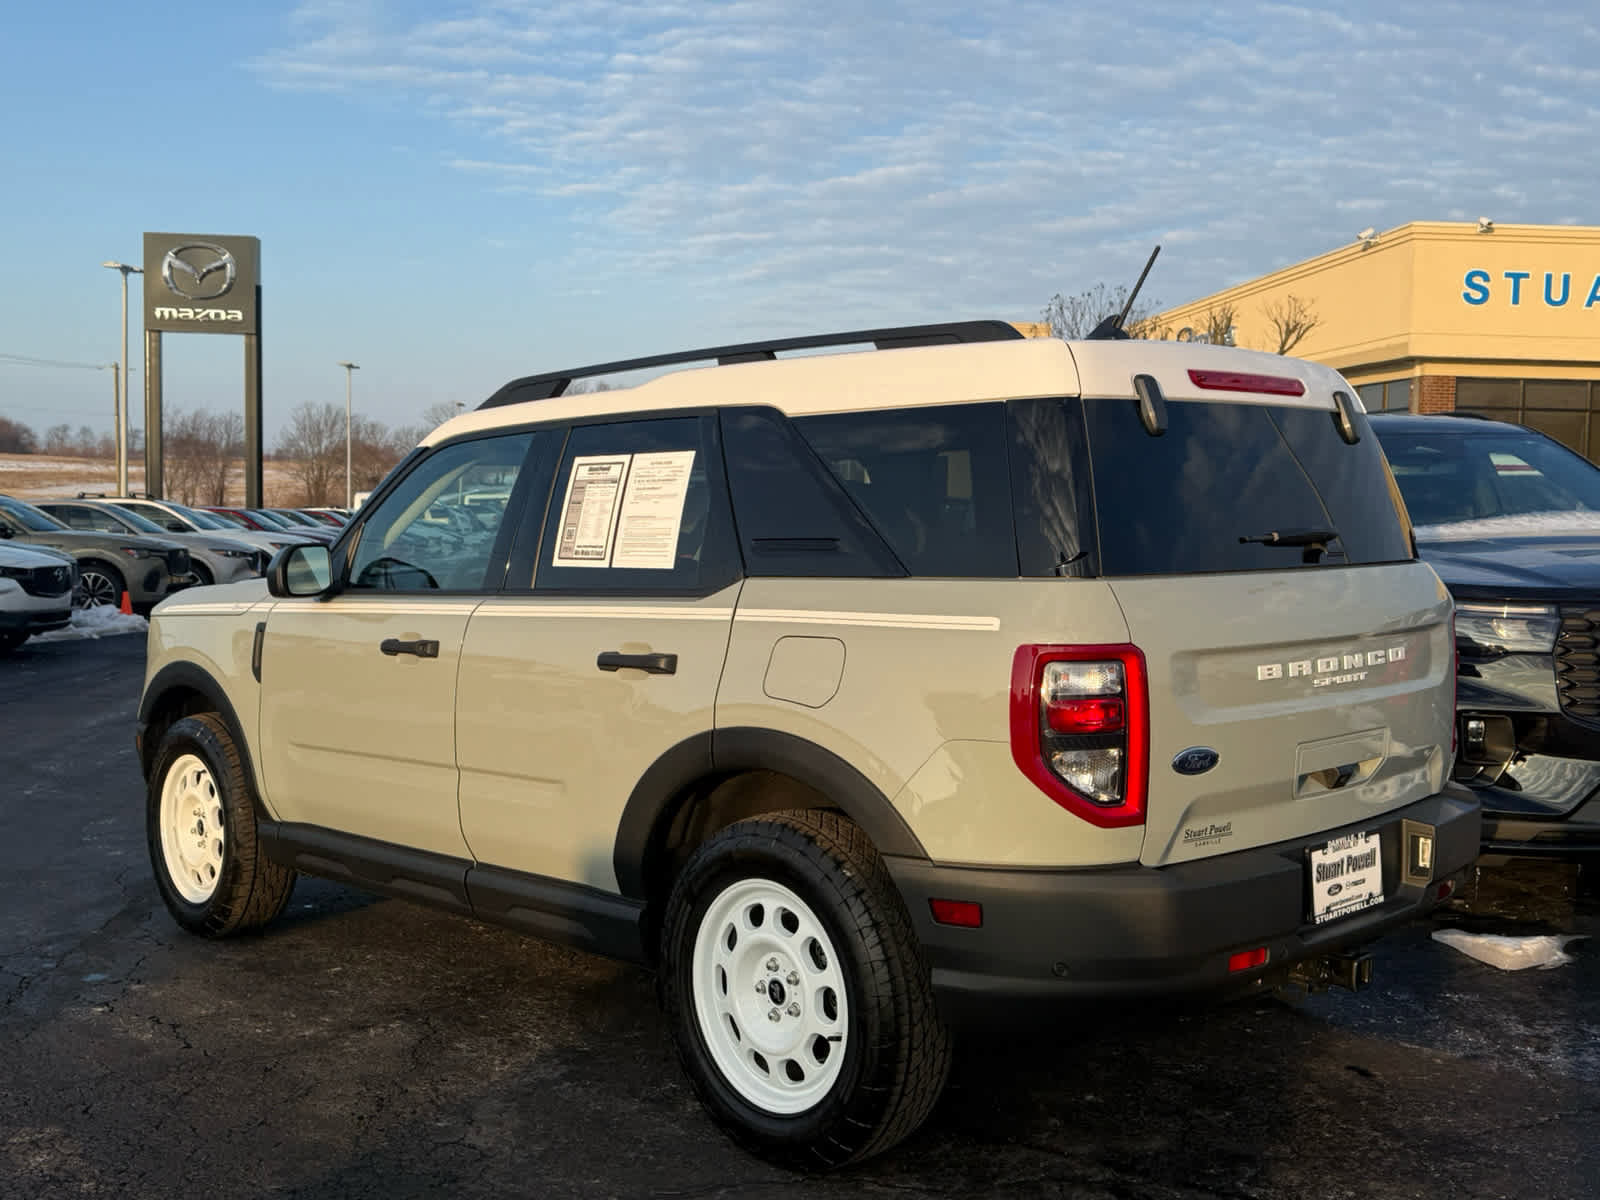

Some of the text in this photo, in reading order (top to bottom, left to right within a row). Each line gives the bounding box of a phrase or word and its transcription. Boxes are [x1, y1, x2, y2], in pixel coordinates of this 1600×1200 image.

[154, 307, 244, 321] mazda
[1257, 646, 1406, 681] BRONCO
[1312, 671, 1369, 688] SPORT
[1184, 822, 1232, 839] Stuart Powell
[1316, 847, 1376, 883] Stuart Powell
[1315, 895, 1384, 924] STUARTPOWELL.COM
